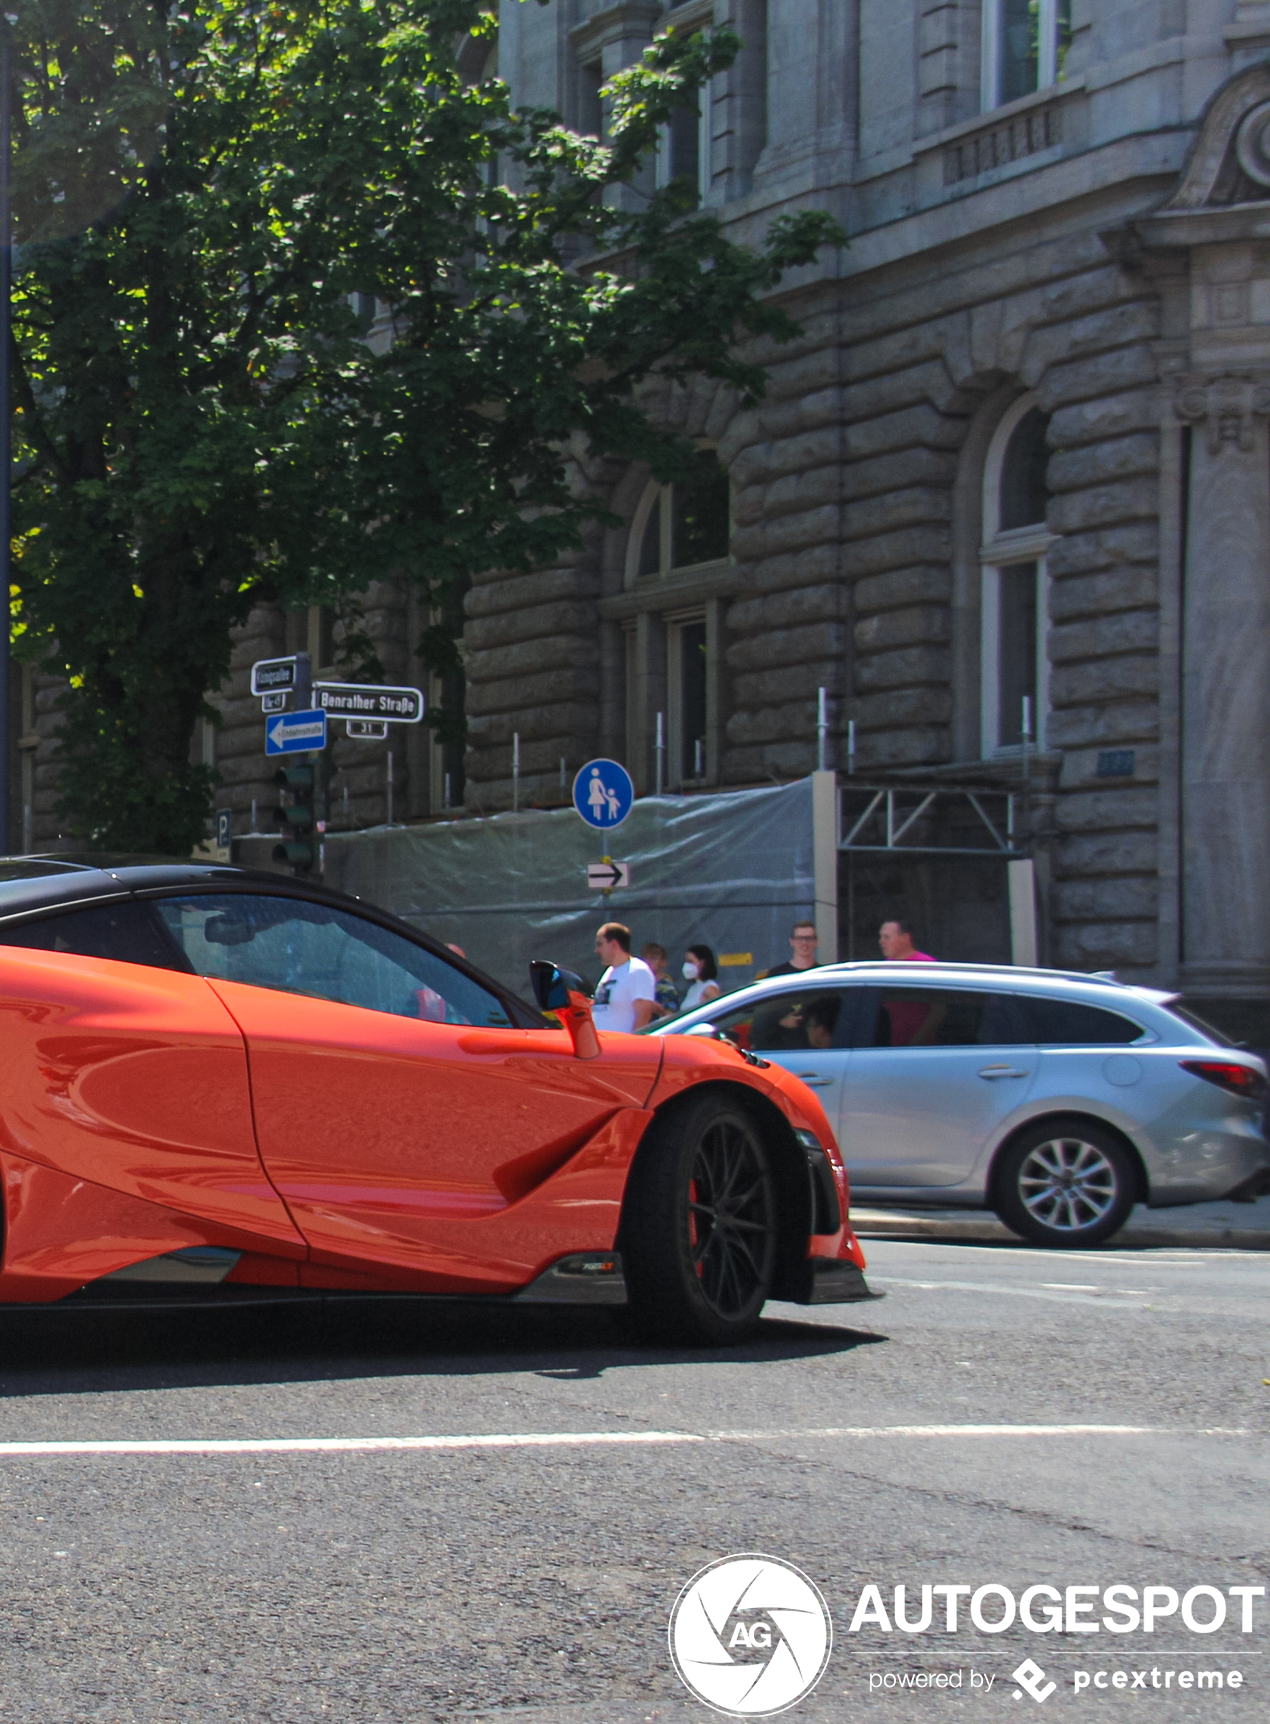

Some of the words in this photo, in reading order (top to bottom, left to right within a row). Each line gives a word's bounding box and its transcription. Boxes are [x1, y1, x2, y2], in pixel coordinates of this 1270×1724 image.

[321, 692, 375, 709] Benrather
[379, 695, 415, 714] Straße
[360, 722, 373, 733] 31
[219, 815, 228, 845] P
